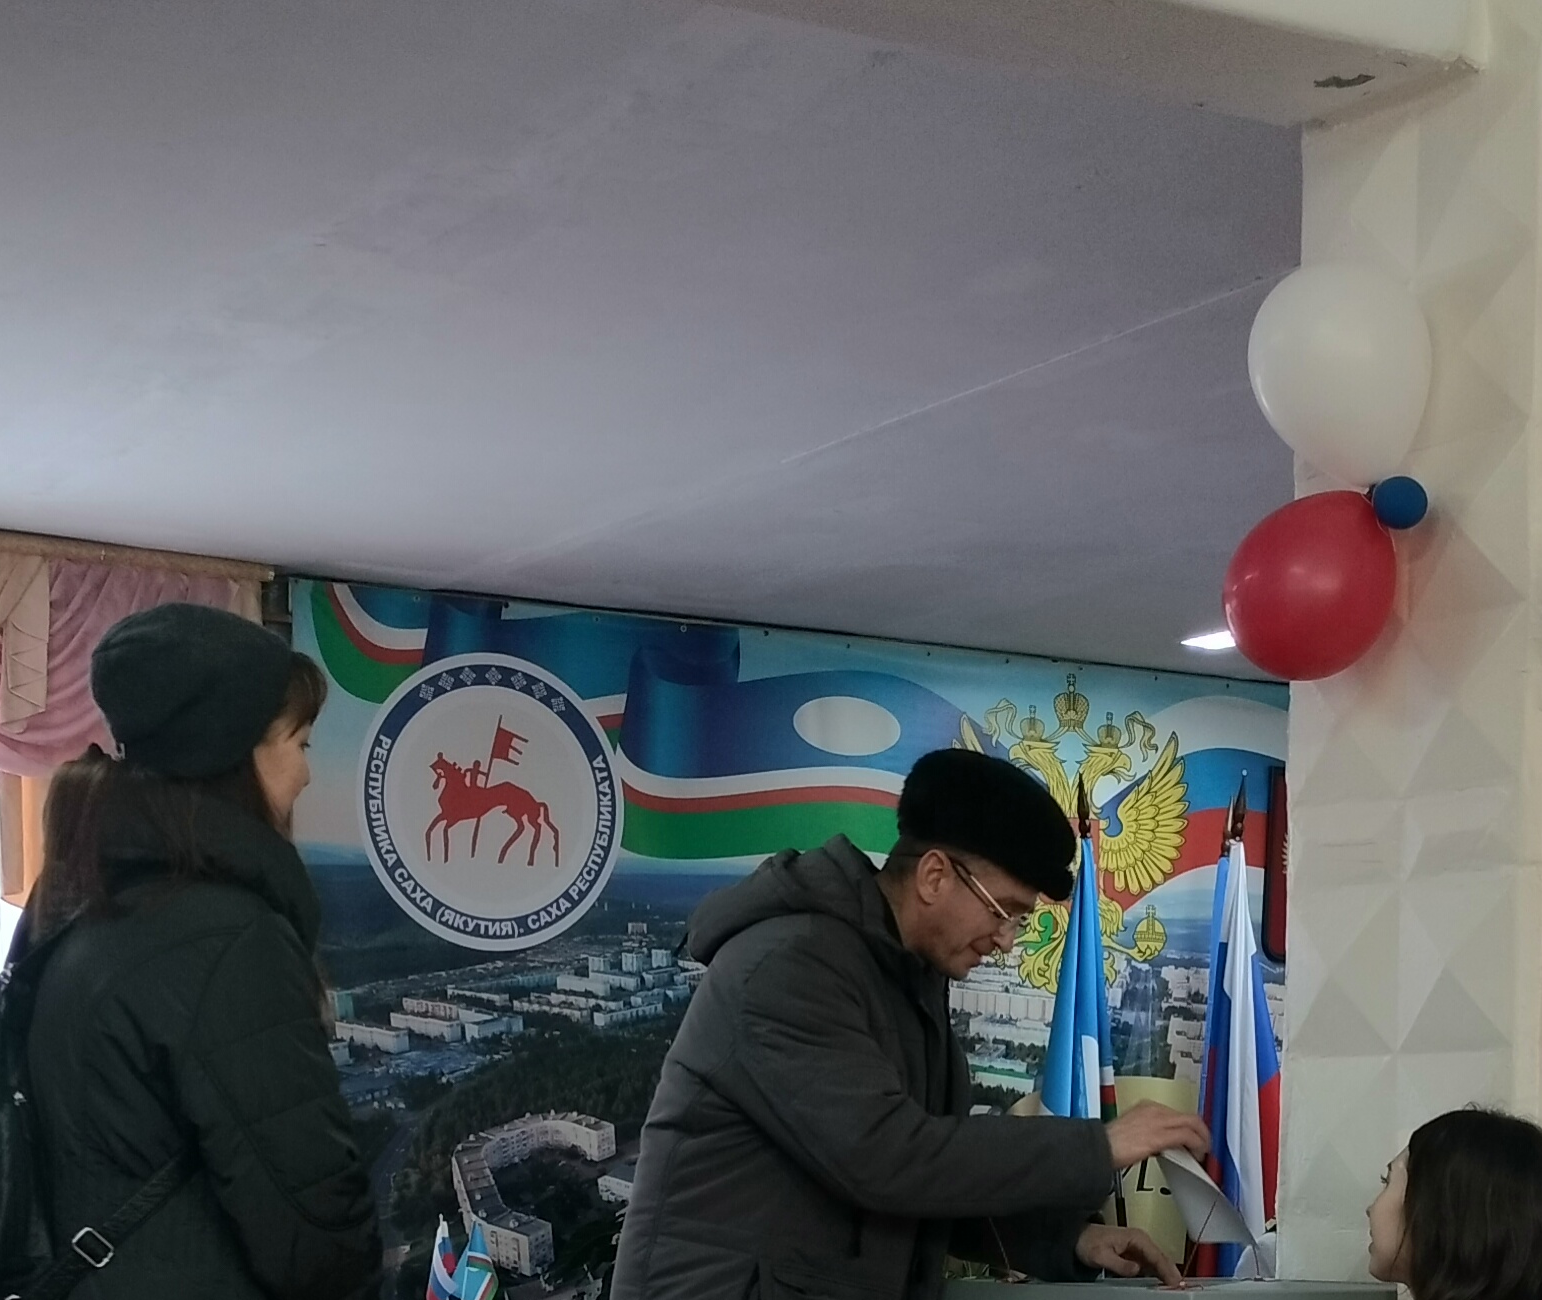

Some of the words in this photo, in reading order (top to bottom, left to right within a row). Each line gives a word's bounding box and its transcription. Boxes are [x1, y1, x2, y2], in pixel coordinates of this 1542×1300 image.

[367, 734, 396, 868] РЕСПУБЛИКА
[394, 867, 433, 914] САХА
[527, 898, 571, 930] САХА
[569, 754, 613, 902] РЕСПУБЛИКАТА
